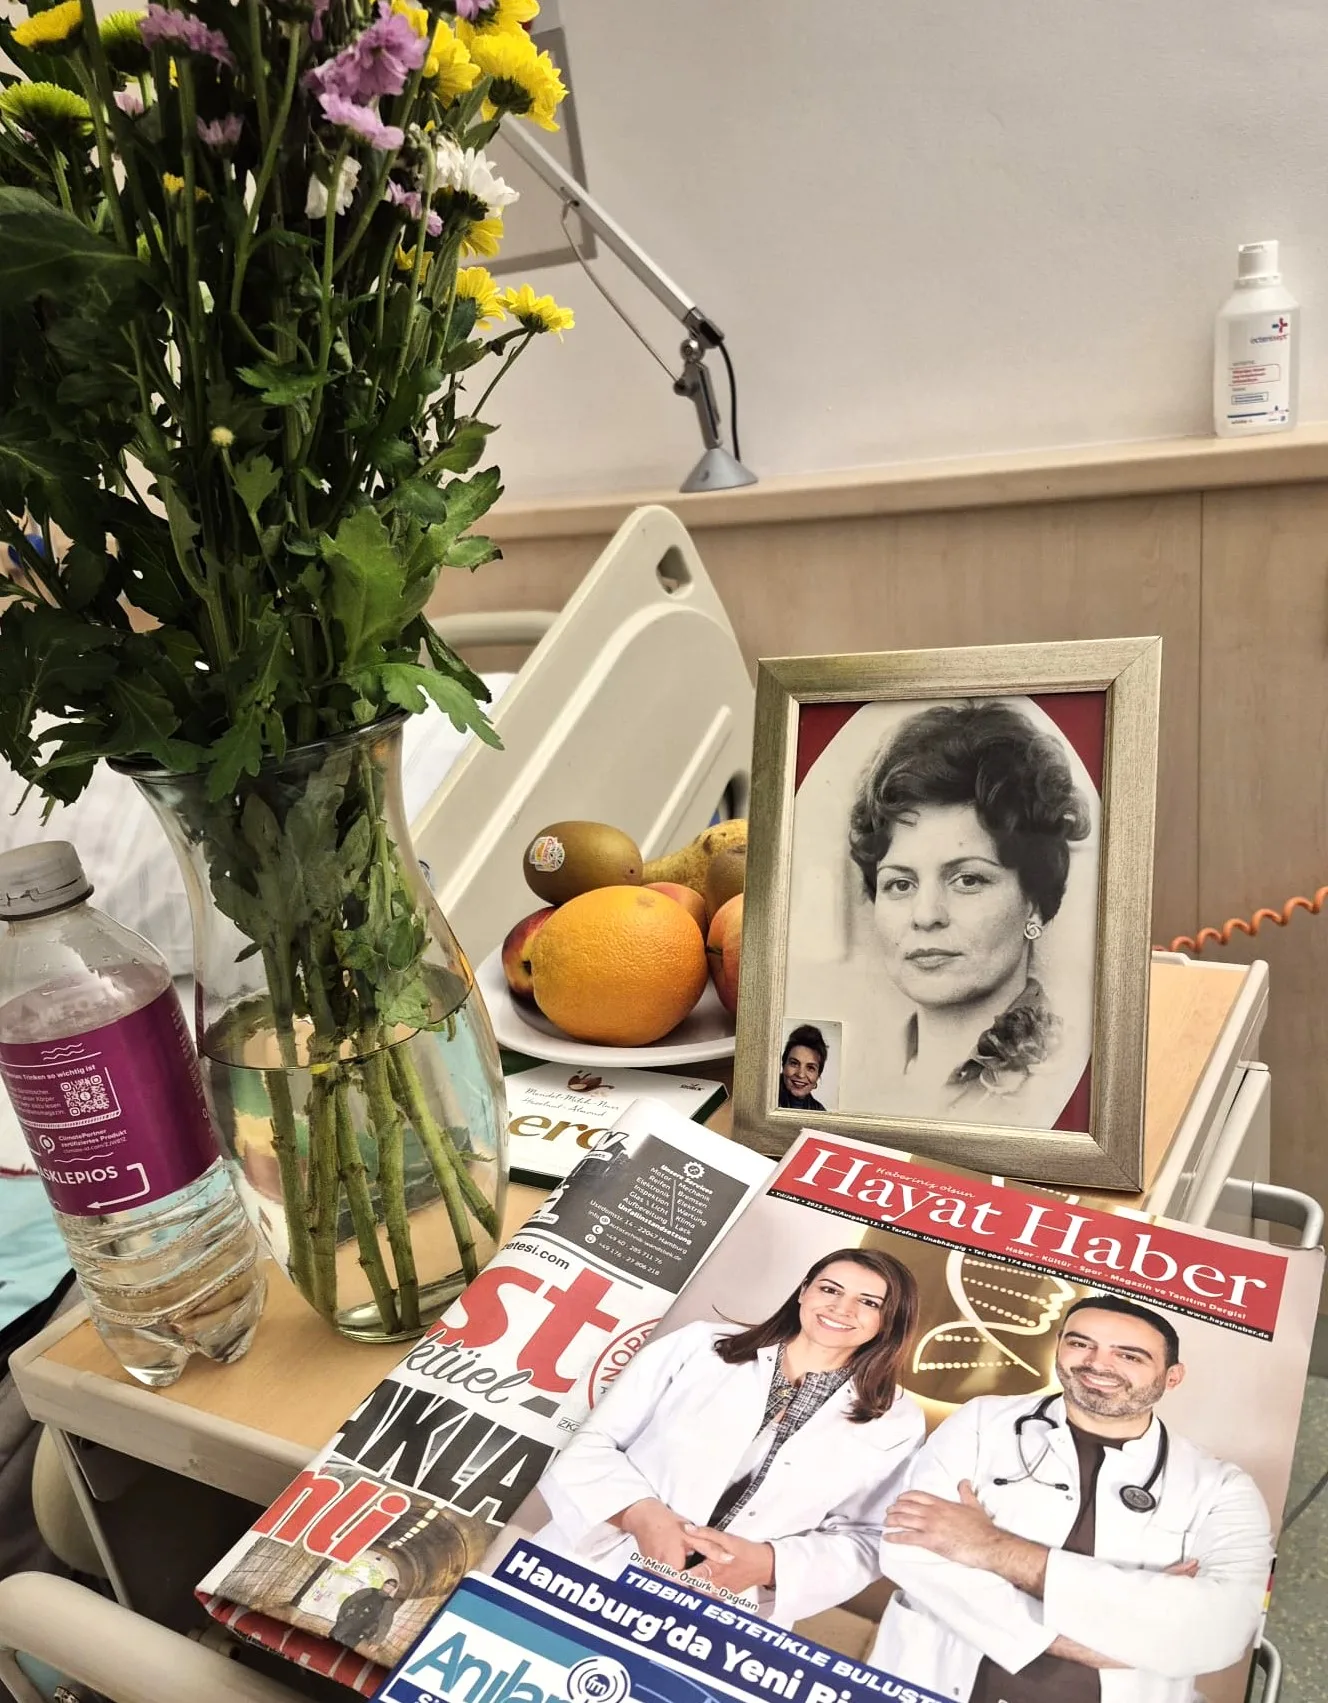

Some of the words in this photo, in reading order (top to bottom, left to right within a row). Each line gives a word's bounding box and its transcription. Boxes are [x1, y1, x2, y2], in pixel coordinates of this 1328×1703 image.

[56, 1068, 85, 1078] wichtig
[86, 1064, 96, 1072] ist
[100, 1129, 127, 1142] Produkt
[508, 1111, 609, 1149] erc
[636, 1176, 671, 1199] Elektronik
[648, 1175, 671, 1191] Reifen
[677, 1190, 708, 1209] Bremsen
[650, 1167, 672, 1182] Motor
[939, 1186, 976, 1198] olsun
[617, 1203, 692, 1246] Unfallinstandsetzung
[622, 1197, 668, 1225] Aufbereitung
[674, 1223, 692, 1236] Lack
[633, 1184, 670, 1207] Inspektion
[677, 1207, 708, 1227] Wartung
[675, 1215, 696, 1229] Klima
[658, 1237, 688, 1255] Hamburg
[793, 1147, 1003, 1236] Hayat
[1010, 1203, 1268, 1309] Haber
[923, 1235, 967, 1252] Unabhängig
[1185, 1310, 1269, 1339] www.hayathaber.de
[1005, 1246, 1034, 1258] Haber
[1041, 1255, 1072, 1268] Kültür
[1079, 1265, 1103, 1276] Spor
[1110, 1274, 1152, 1291] Magazin
[630, 1552, 645, 1563] Dr.
[645, 1559, 678, 1579] Melike
[679, 1570, 712, 1592] Öztürk
[718, 1587, 758, 1611] Dagdan
[626, 1572, 702, 1611] TIBBIN
[702, 1603, 831, 1667] ESTETİKLE
[722, 1642, 804, 1700] Yeni
